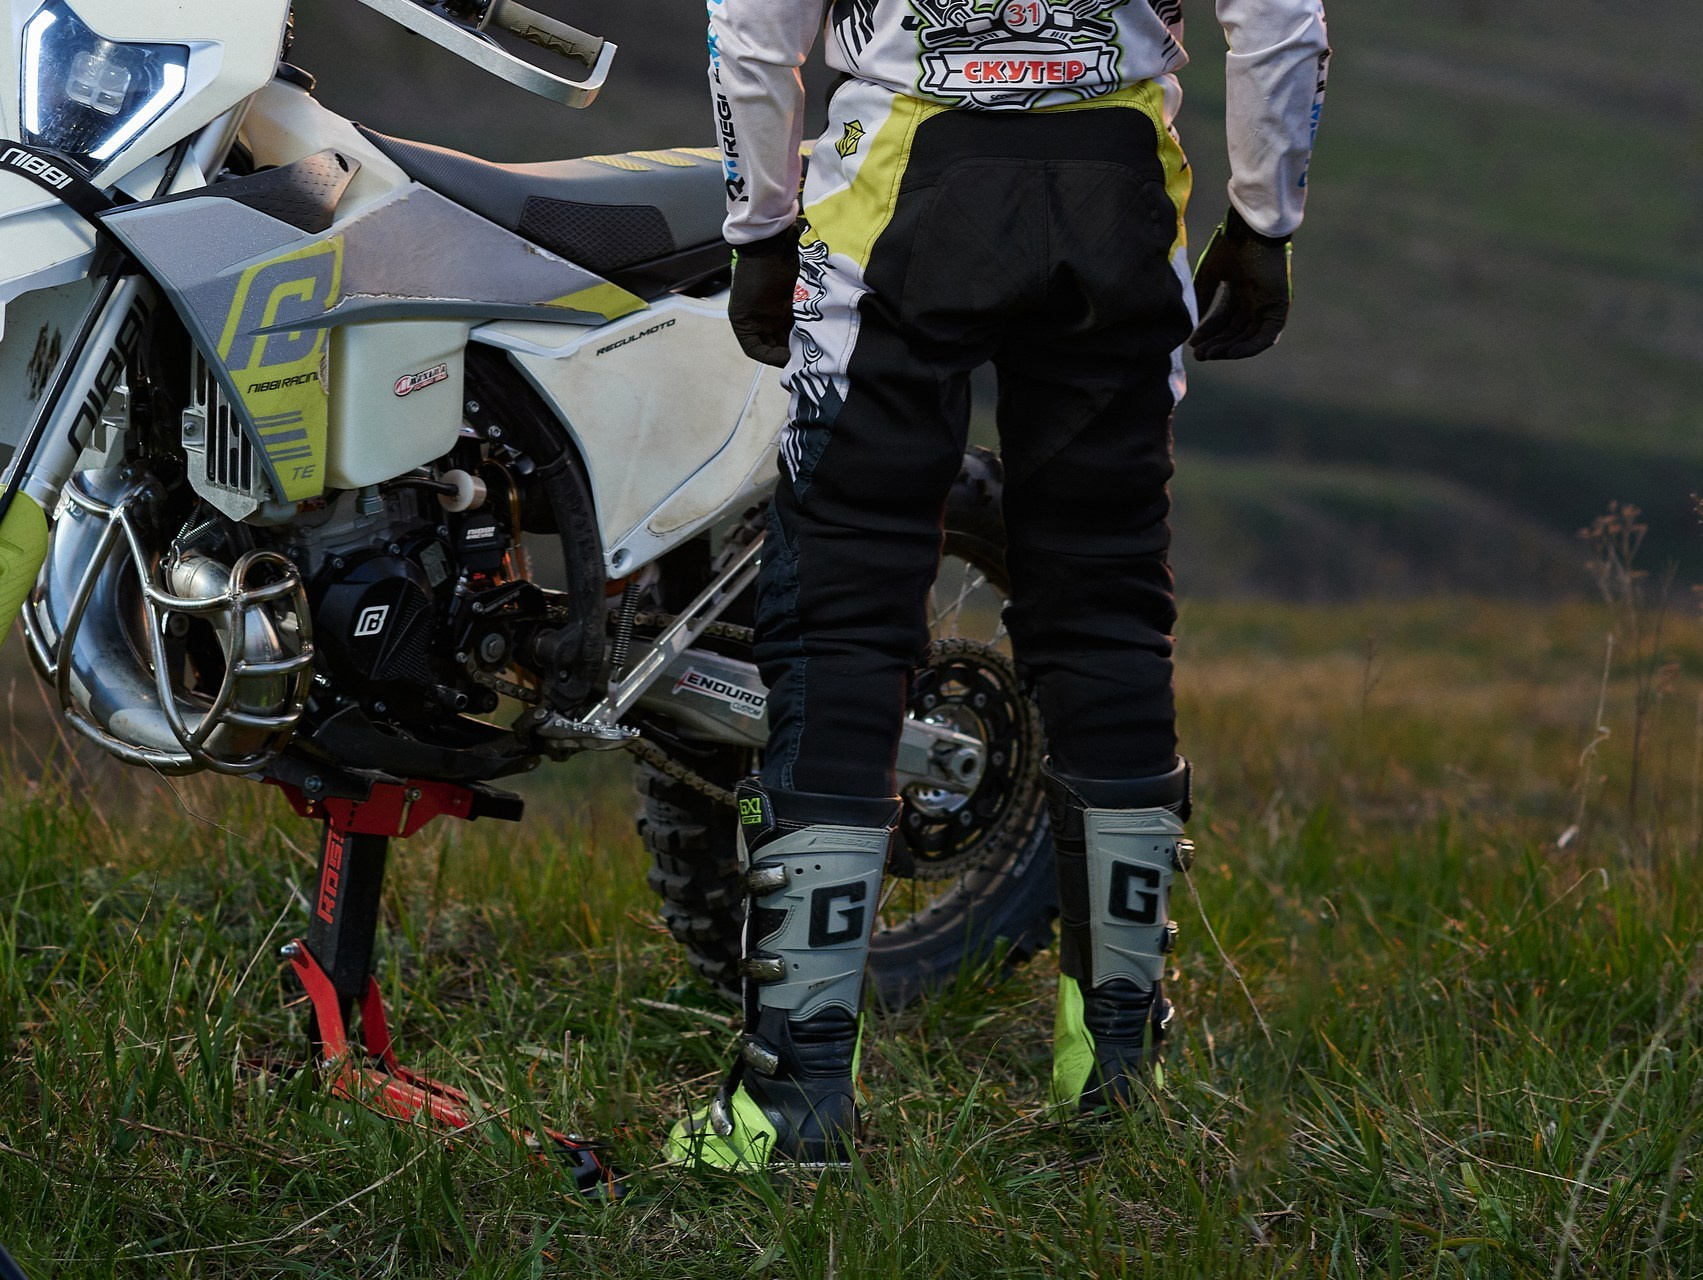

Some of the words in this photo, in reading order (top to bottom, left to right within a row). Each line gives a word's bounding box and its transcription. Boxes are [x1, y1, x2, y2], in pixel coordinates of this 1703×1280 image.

[1007, 3, 1040, 26] 31
[963, 59, 1085, 84] СКУТЕР
[0, 147, 74, 190] NIBBI
[596, 318, 676, 356] REGULMOTO
[247, 379, 282, 394] NIBBI
[281, 371, 320, 388] RACIN
[292, 464, 316, 480] TE
[687, 673, 766, 707] ENDURO
[1109, 860, 1160, 924] G
[808, 881, 866, 947] G
